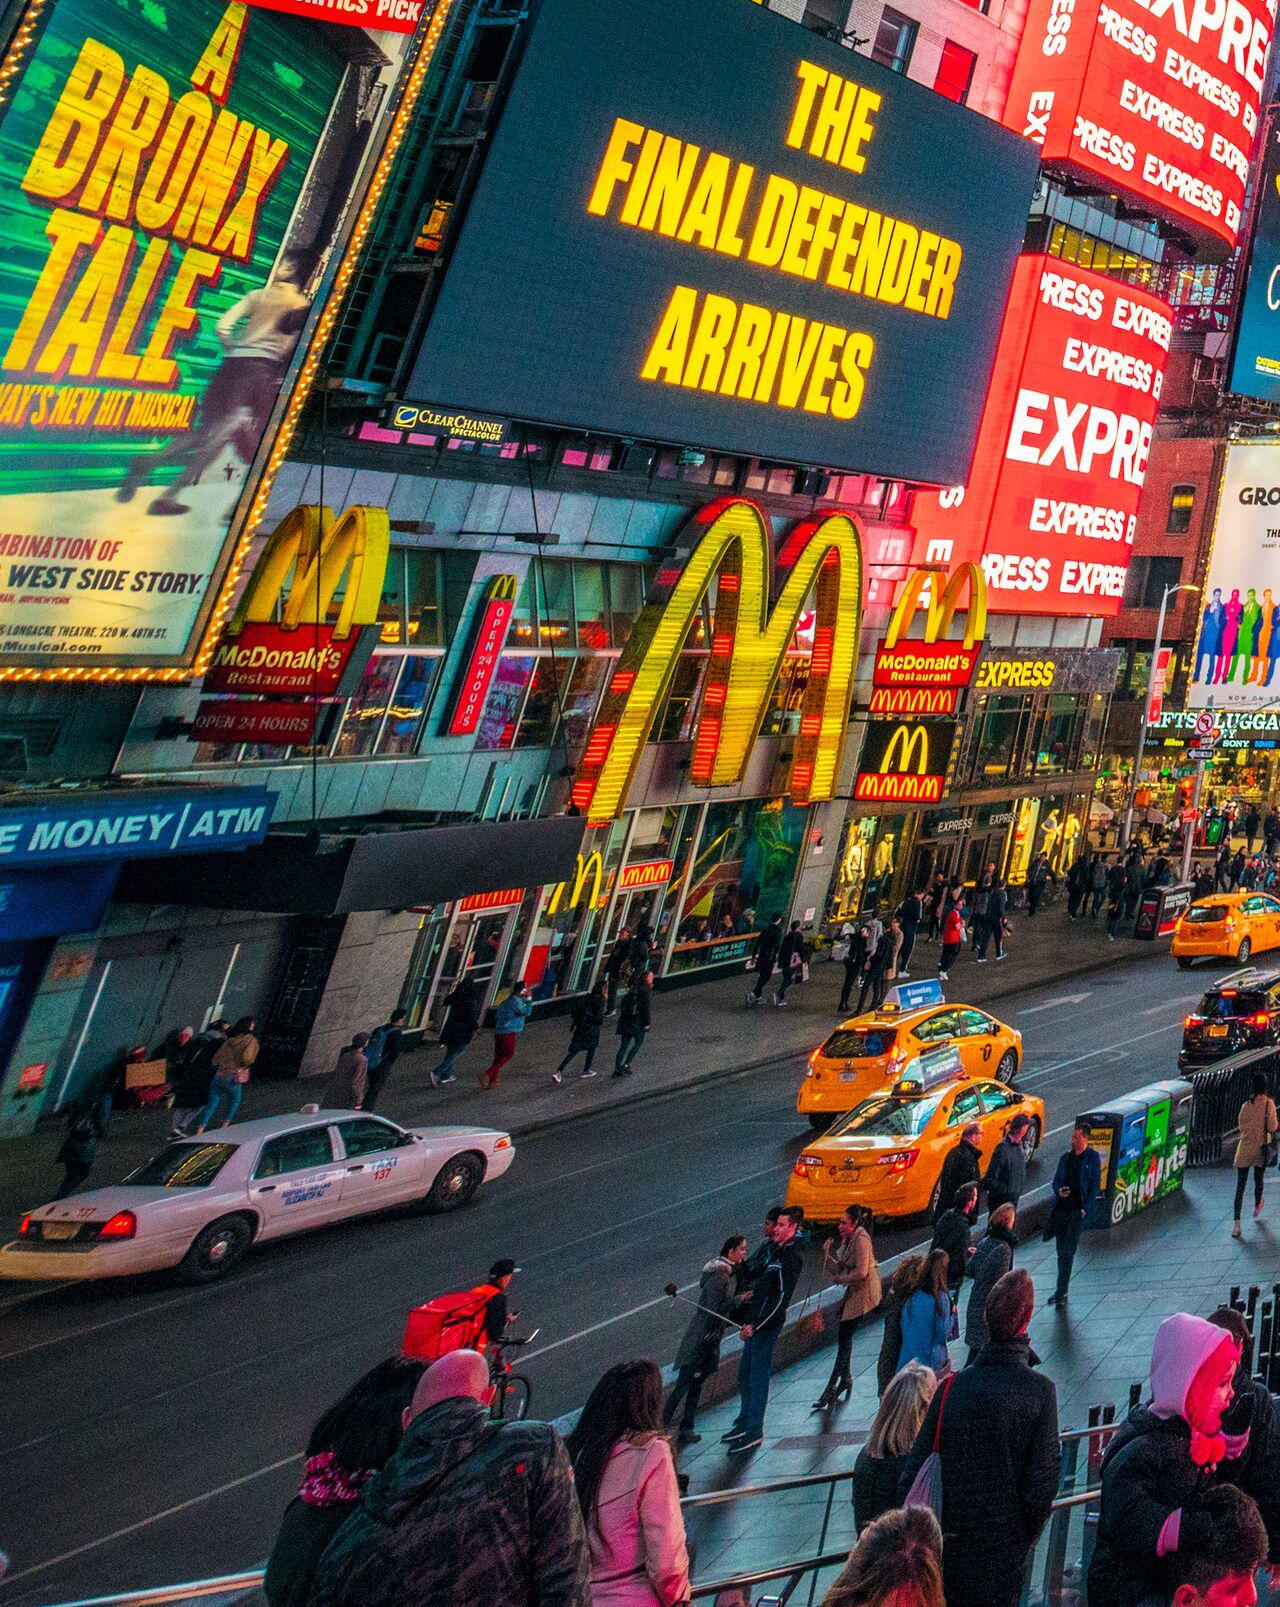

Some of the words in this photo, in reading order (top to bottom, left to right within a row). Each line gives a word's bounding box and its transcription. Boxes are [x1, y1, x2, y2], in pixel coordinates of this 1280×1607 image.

[190, 0, 249, 99] A
[785, 60, 882, 174] THE
[1119, 78, 1206, 151] EXPRESS
[21, 37, 290, 259] BRONX
[587, 117, 755, 257] FINAL
[747, 174, 963, 320] DEFENDER
[2, 207, 221, 384] TALE
[640, 285, 875, 420] ARRIVES
[1062, 337, 1153, 395] EXPRESS
[50, 387, 97, 425] NEW
[96, 390, 129, 426] HIT
[127, 392, 196, 428] MUSICAL
[449, 426, 502, 442] SPECTACOLOR
[96, 540, 123, 562] OF
[7, 564, 76, 590] WEST
[77, 567, 130, 592] SIDE
[215, 644, 342, 672] McDonald's
[878, 654, 970, 671] McDonald's
[226, 671, 313, 688] Restaurant
[890, 671, 952, 682] Restaurant
[975, 660, 1056, 688] EXPRESS
[258, 714, 310, 733] HOURS
[1222, 739, 1250, 748] SONY
[27, 810, 171, 854] MONEY
[188, 806, 269, 837] ATM
[937, 818, 974, 833] EXPRESS
[373, 1168, 392, 1181] 137
